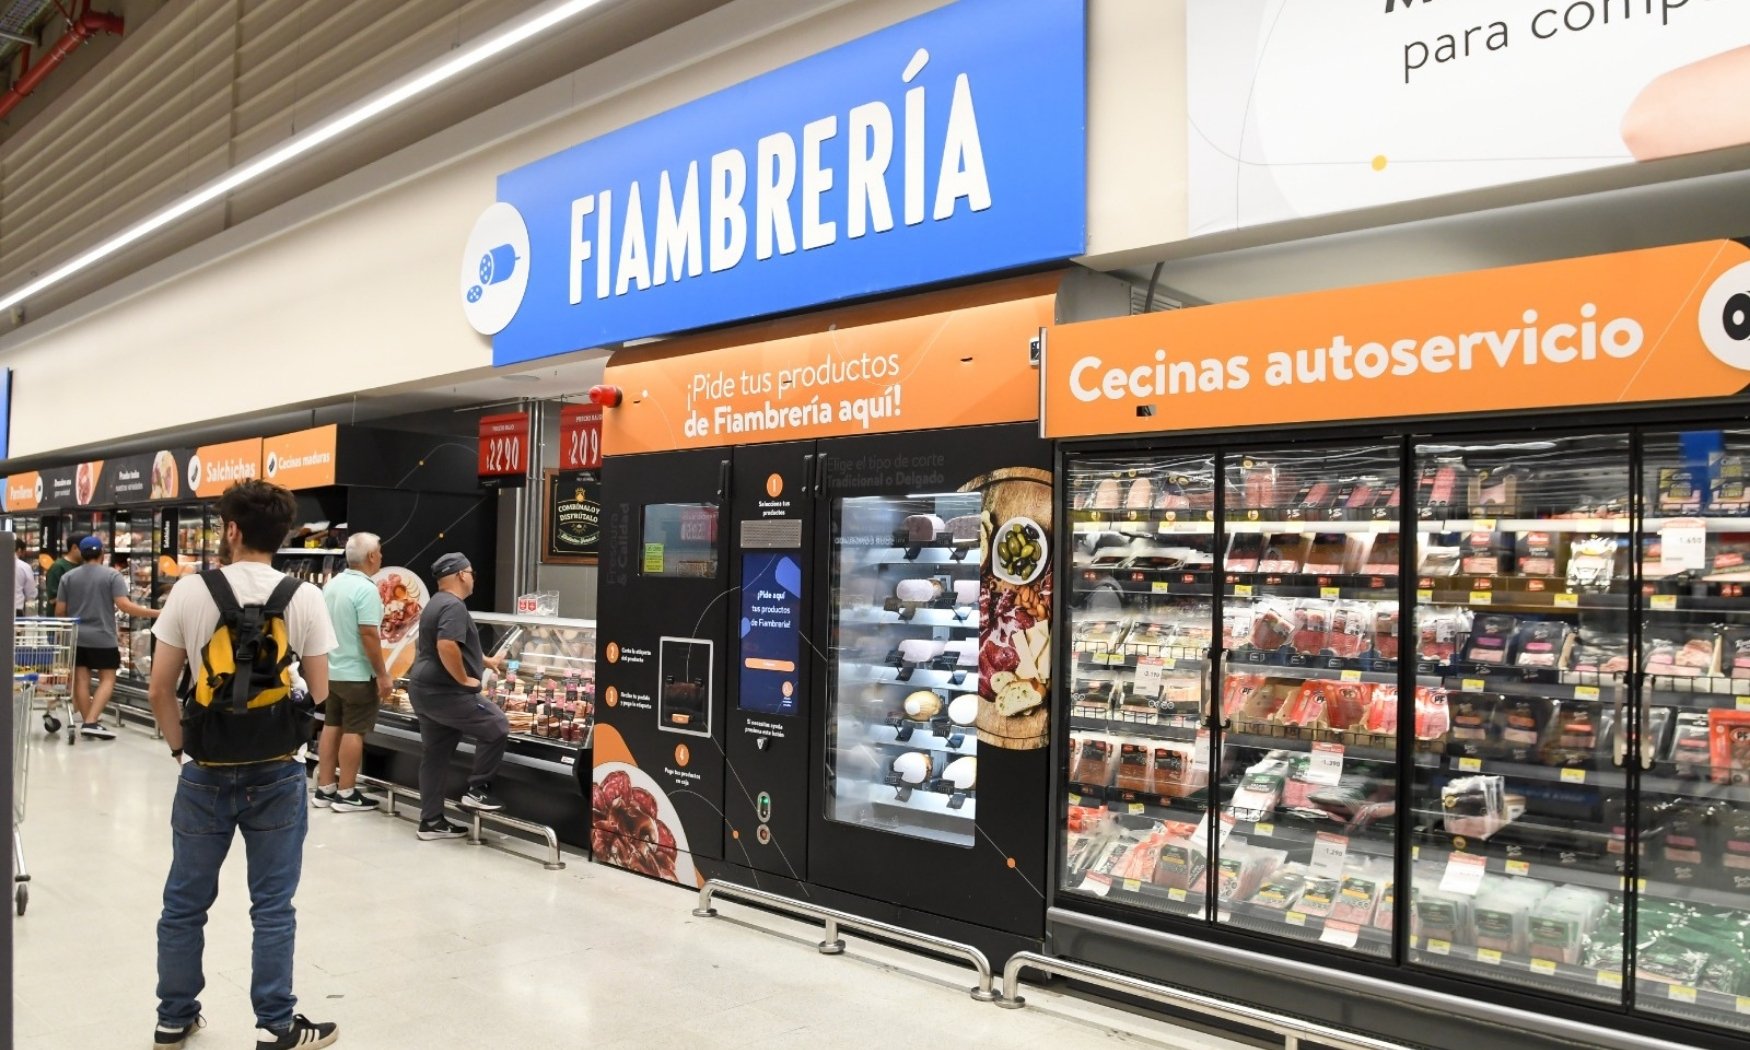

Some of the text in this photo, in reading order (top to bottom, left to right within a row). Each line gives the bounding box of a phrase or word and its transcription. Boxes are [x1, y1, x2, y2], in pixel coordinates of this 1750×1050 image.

[1405, 20, 1509, 84] para
[569, 47, 992, 306] FIAMBRERÍA
[686, 352, 901, 411] ¡Pide tus productos
[1068, 302, 1645, 404] Cecinas autoservicio
[684, 383, 902, 438] de Fiambrería aquí!
[206, 457, 256, 483] Salchichas
[278, 450, 331, 470] Cecinas maduras
[761, 604, 791, 615] productos
